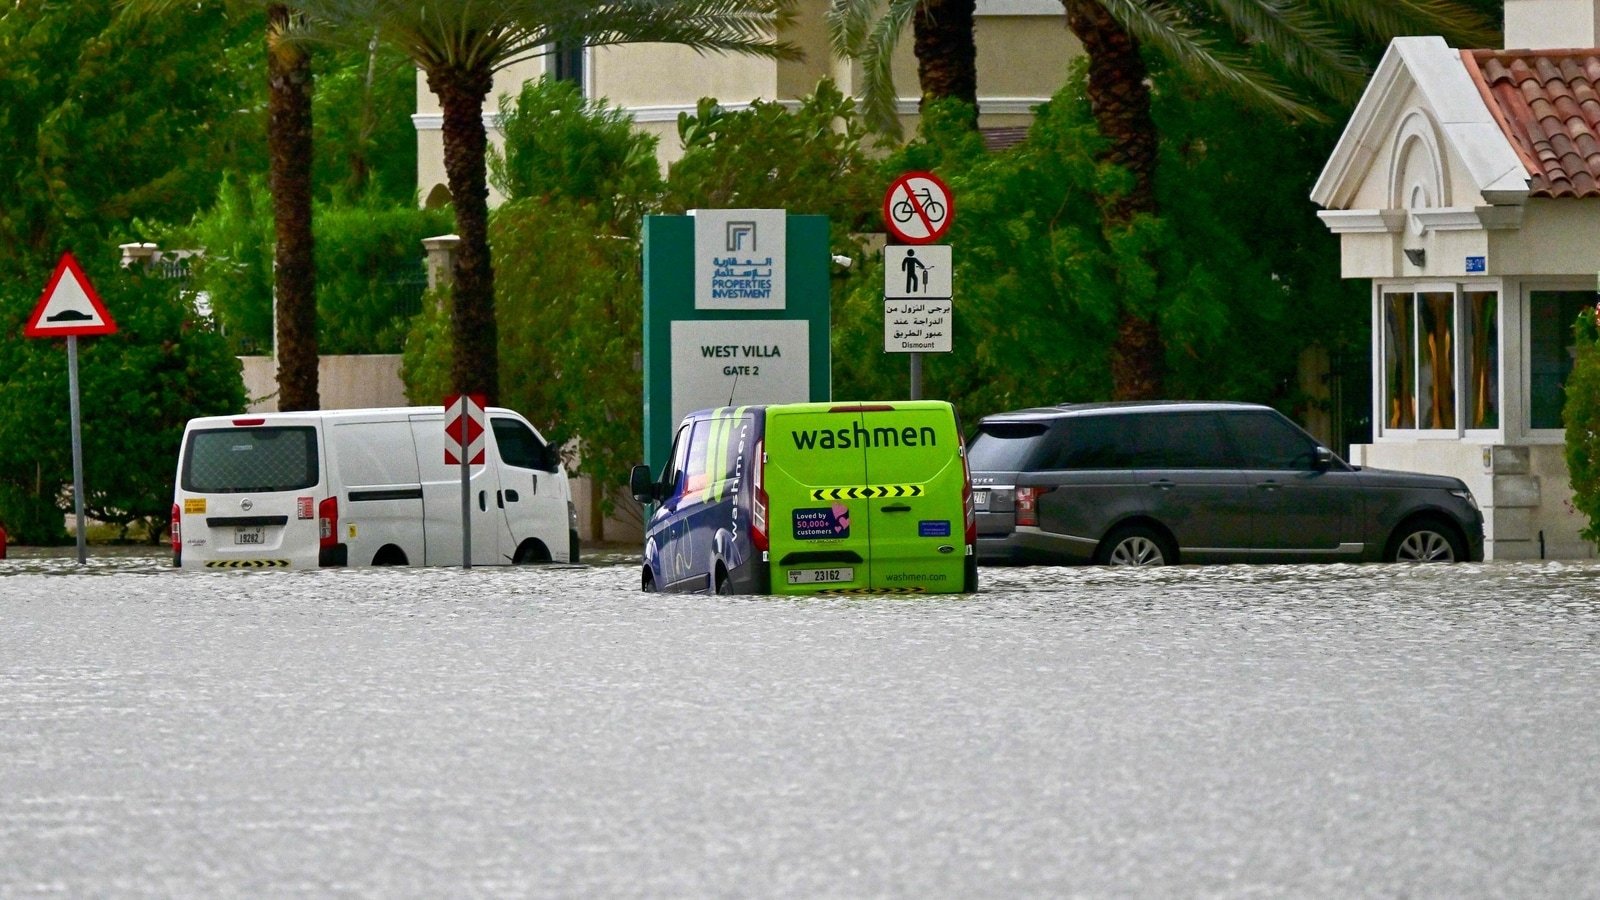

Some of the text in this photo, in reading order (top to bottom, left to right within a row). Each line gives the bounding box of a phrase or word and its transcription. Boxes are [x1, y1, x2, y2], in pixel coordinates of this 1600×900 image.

[712, 280, 772, 288] PROPERTIES
[712, 289, 771, 298] INVESTMENT
[886, 304, 950, 314] يرجى النزول من
[913, 317, 943, 327] الدراجة
[893, 329, 943, 339] عبور الطريق
[701, 345, 781, 358] WEST VILLA
[723, 366, 760, 376] GATE 2
[791, 420, 936, 450] washmen
[731, 424, 748, 542] washmen
[796, 520, 830, 529] 50,000+
[814, 570, 840, 581] 23162
[885, 572, 947, 581] washmen.com
